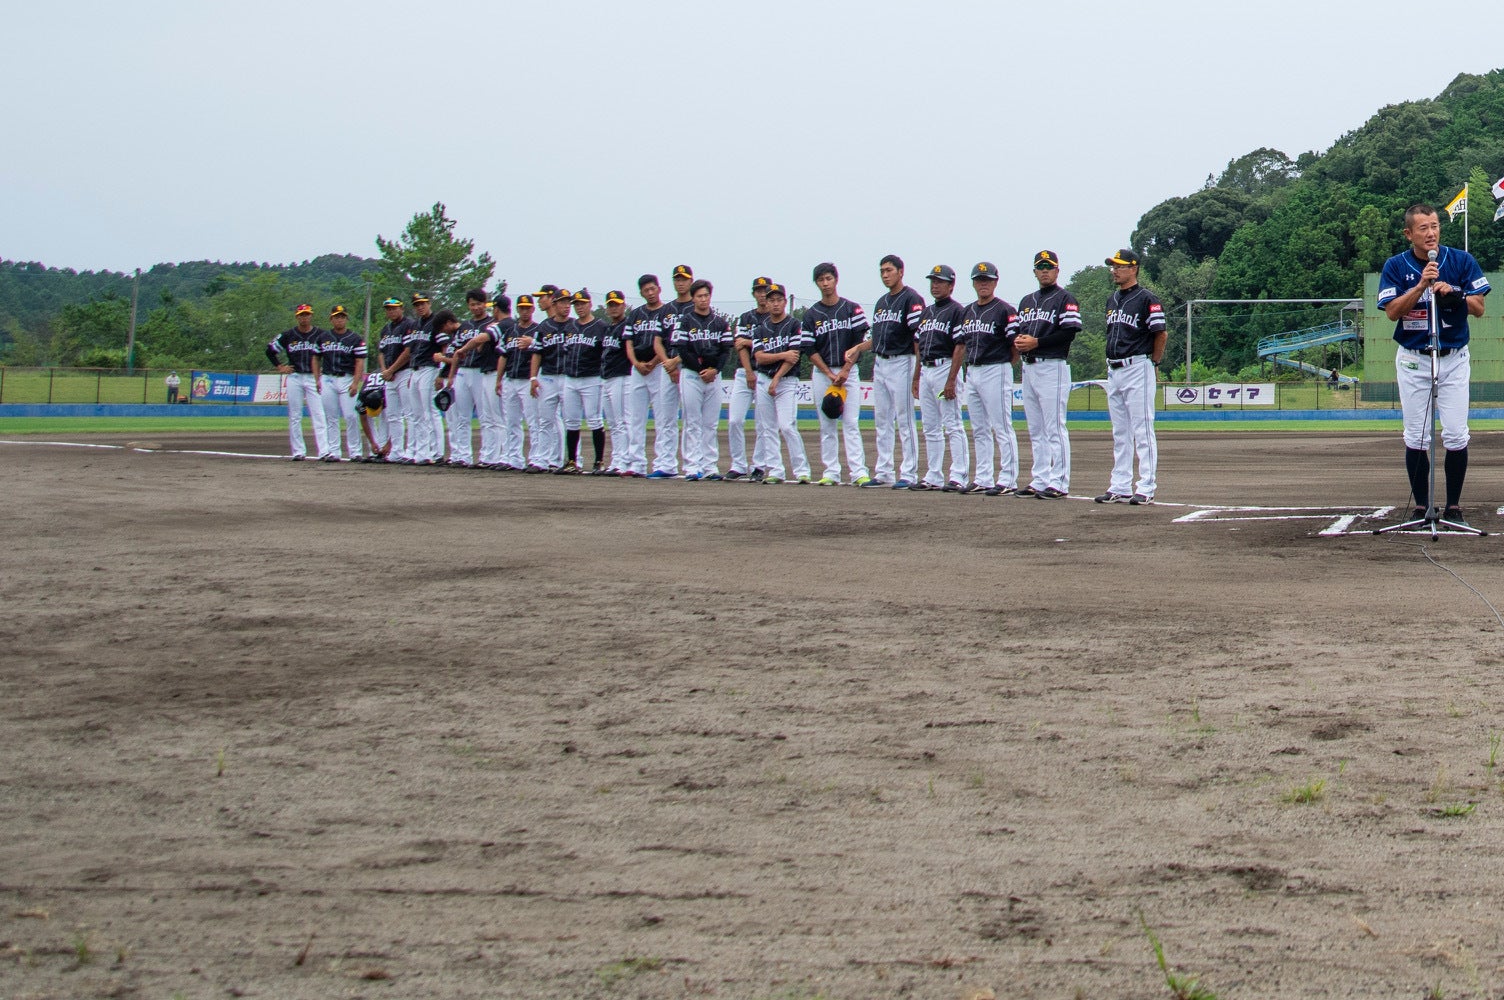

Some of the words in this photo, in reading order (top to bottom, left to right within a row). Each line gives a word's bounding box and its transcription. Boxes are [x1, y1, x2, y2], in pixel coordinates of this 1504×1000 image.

[663, 313, 684, 329] Soft
[873, 309, 903, 324] SoftBank
[1018, 307, 1057, 325] SoftBank
[633, 319, 657, 335] SoftB
[918, 319, 951, 335] SoftBank
[962, 319, 997, 335] SoftBank
[289, 342, 317, 352] SoftBa
[1208, 387, 1260, 400] セイア
